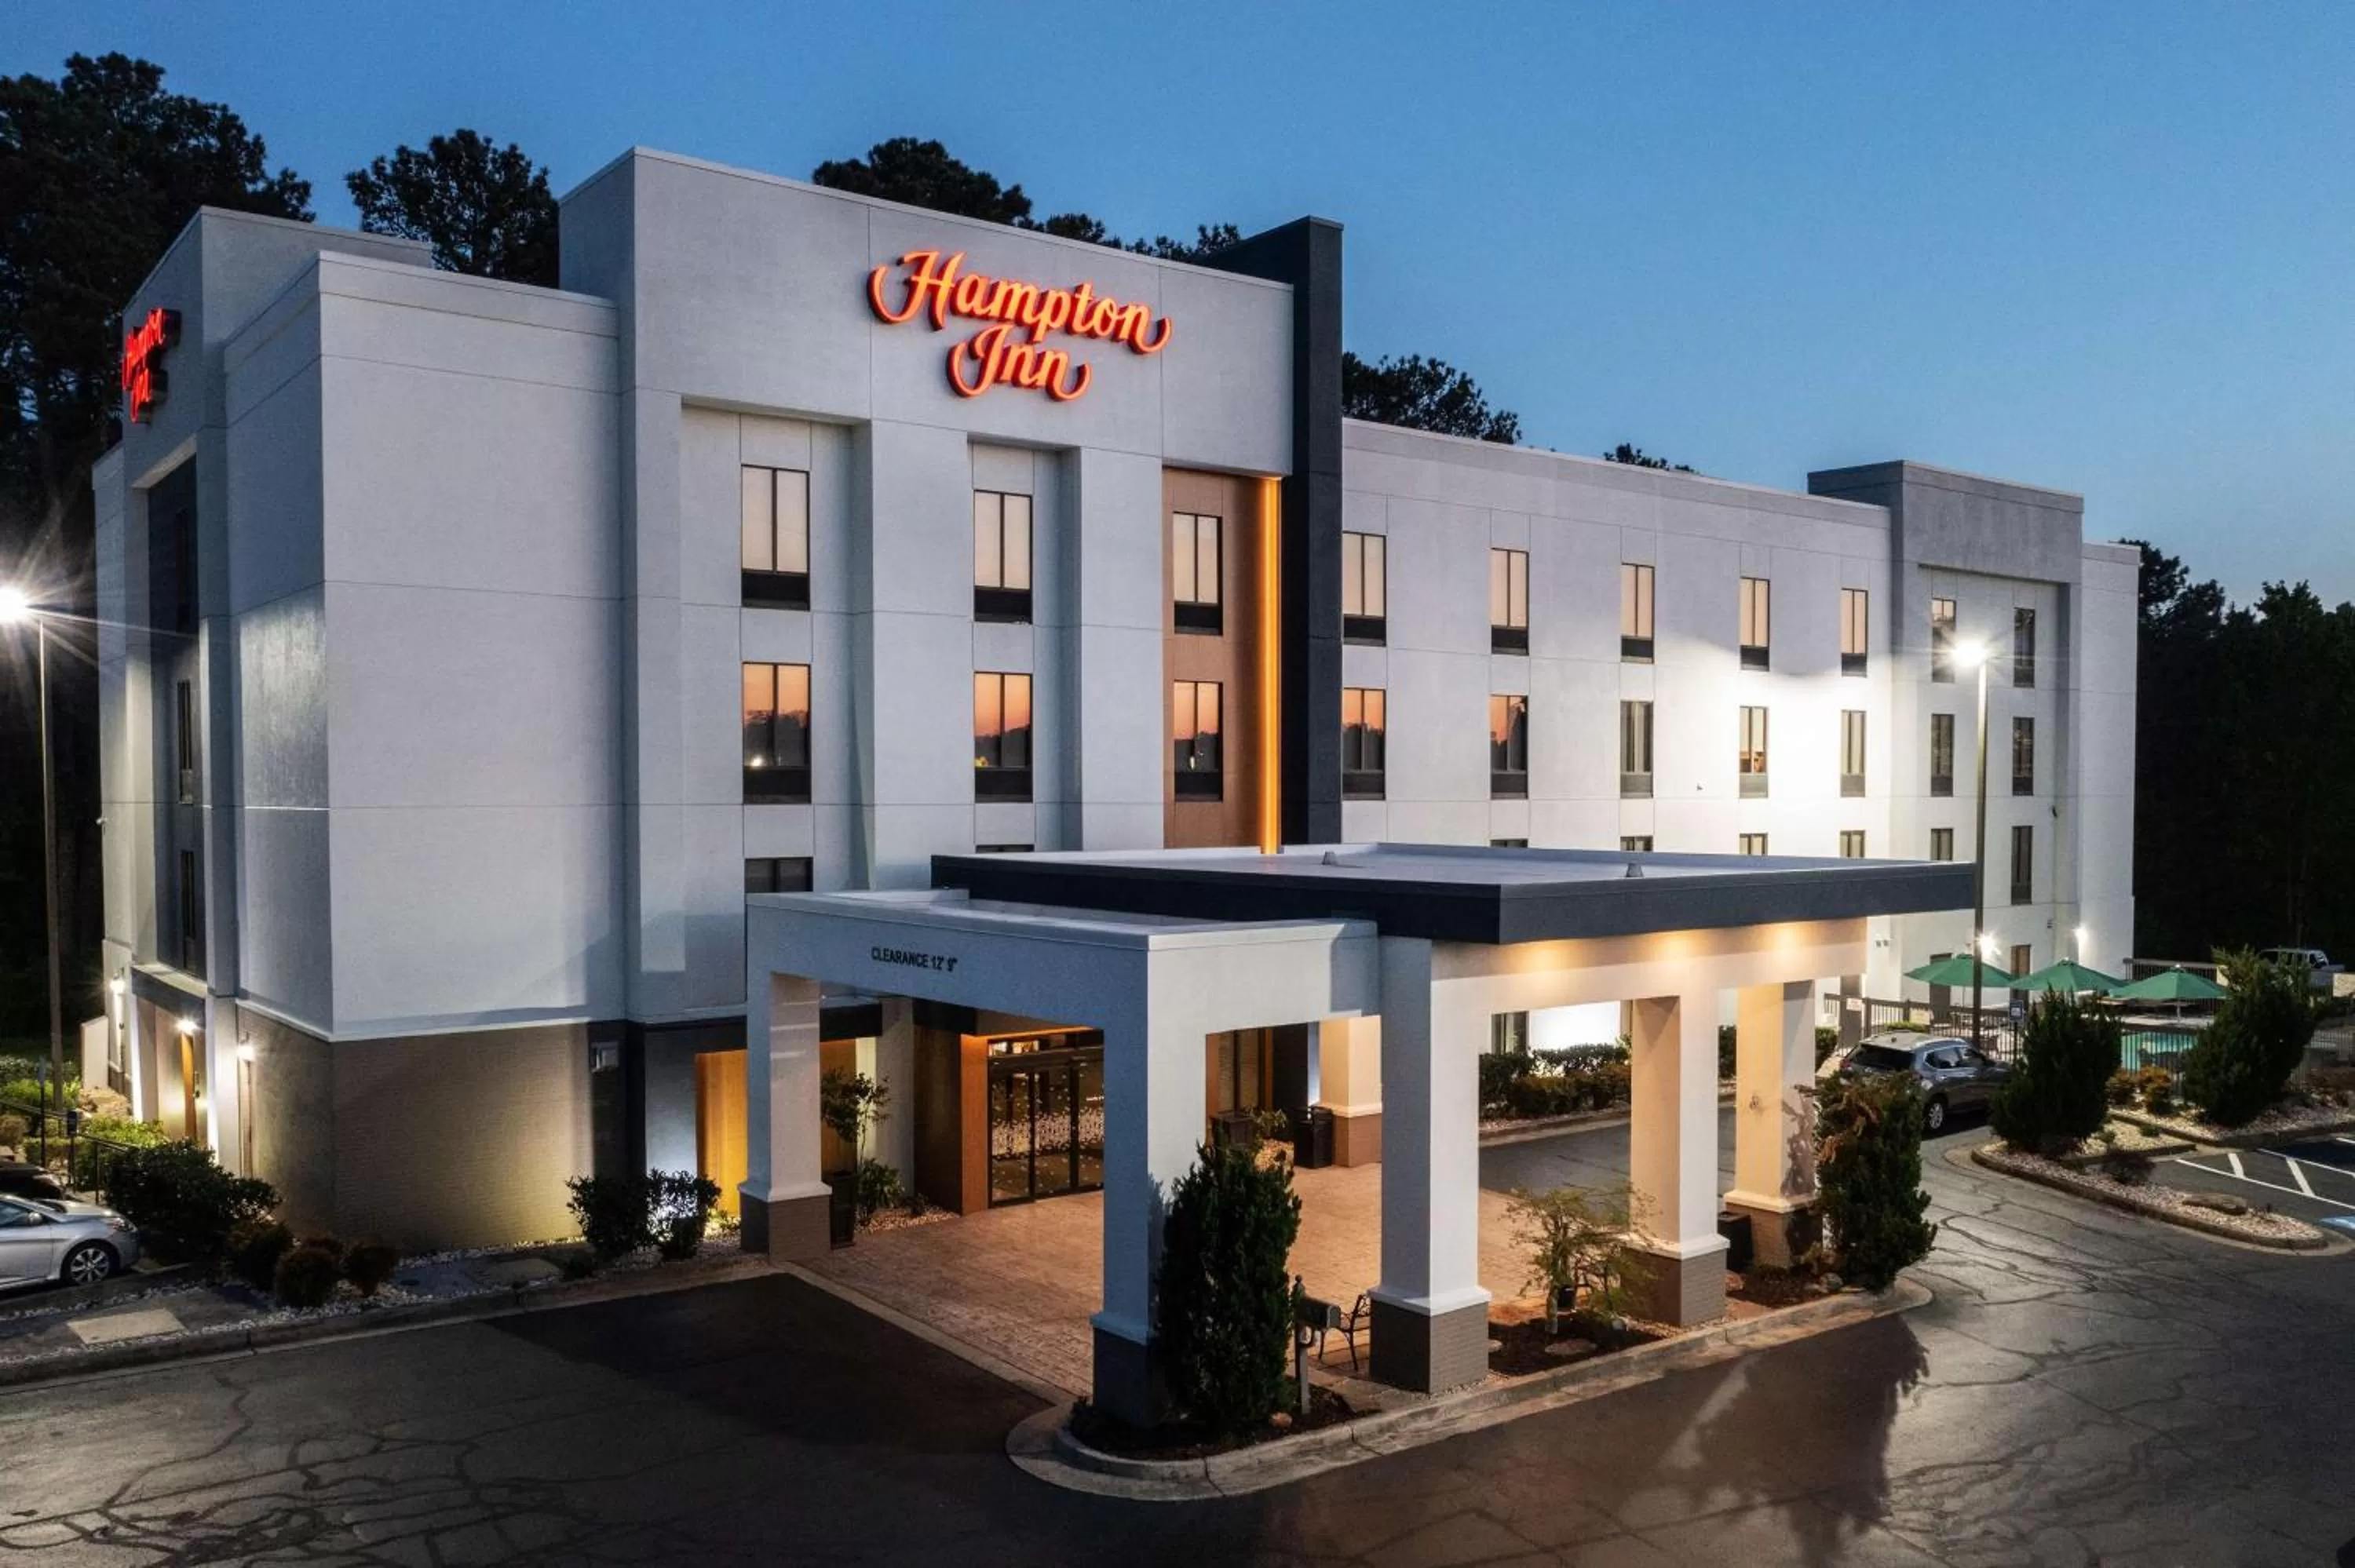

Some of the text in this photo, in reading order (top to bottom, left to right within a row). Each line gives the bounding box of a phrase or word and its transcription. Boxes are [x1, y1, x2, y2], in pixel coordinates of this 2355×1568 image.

[867, 250, 1173, 355] Hampton
[947, 323, 1092, 402] Inn
[871, 946, 929, 968] CLEARANCE
